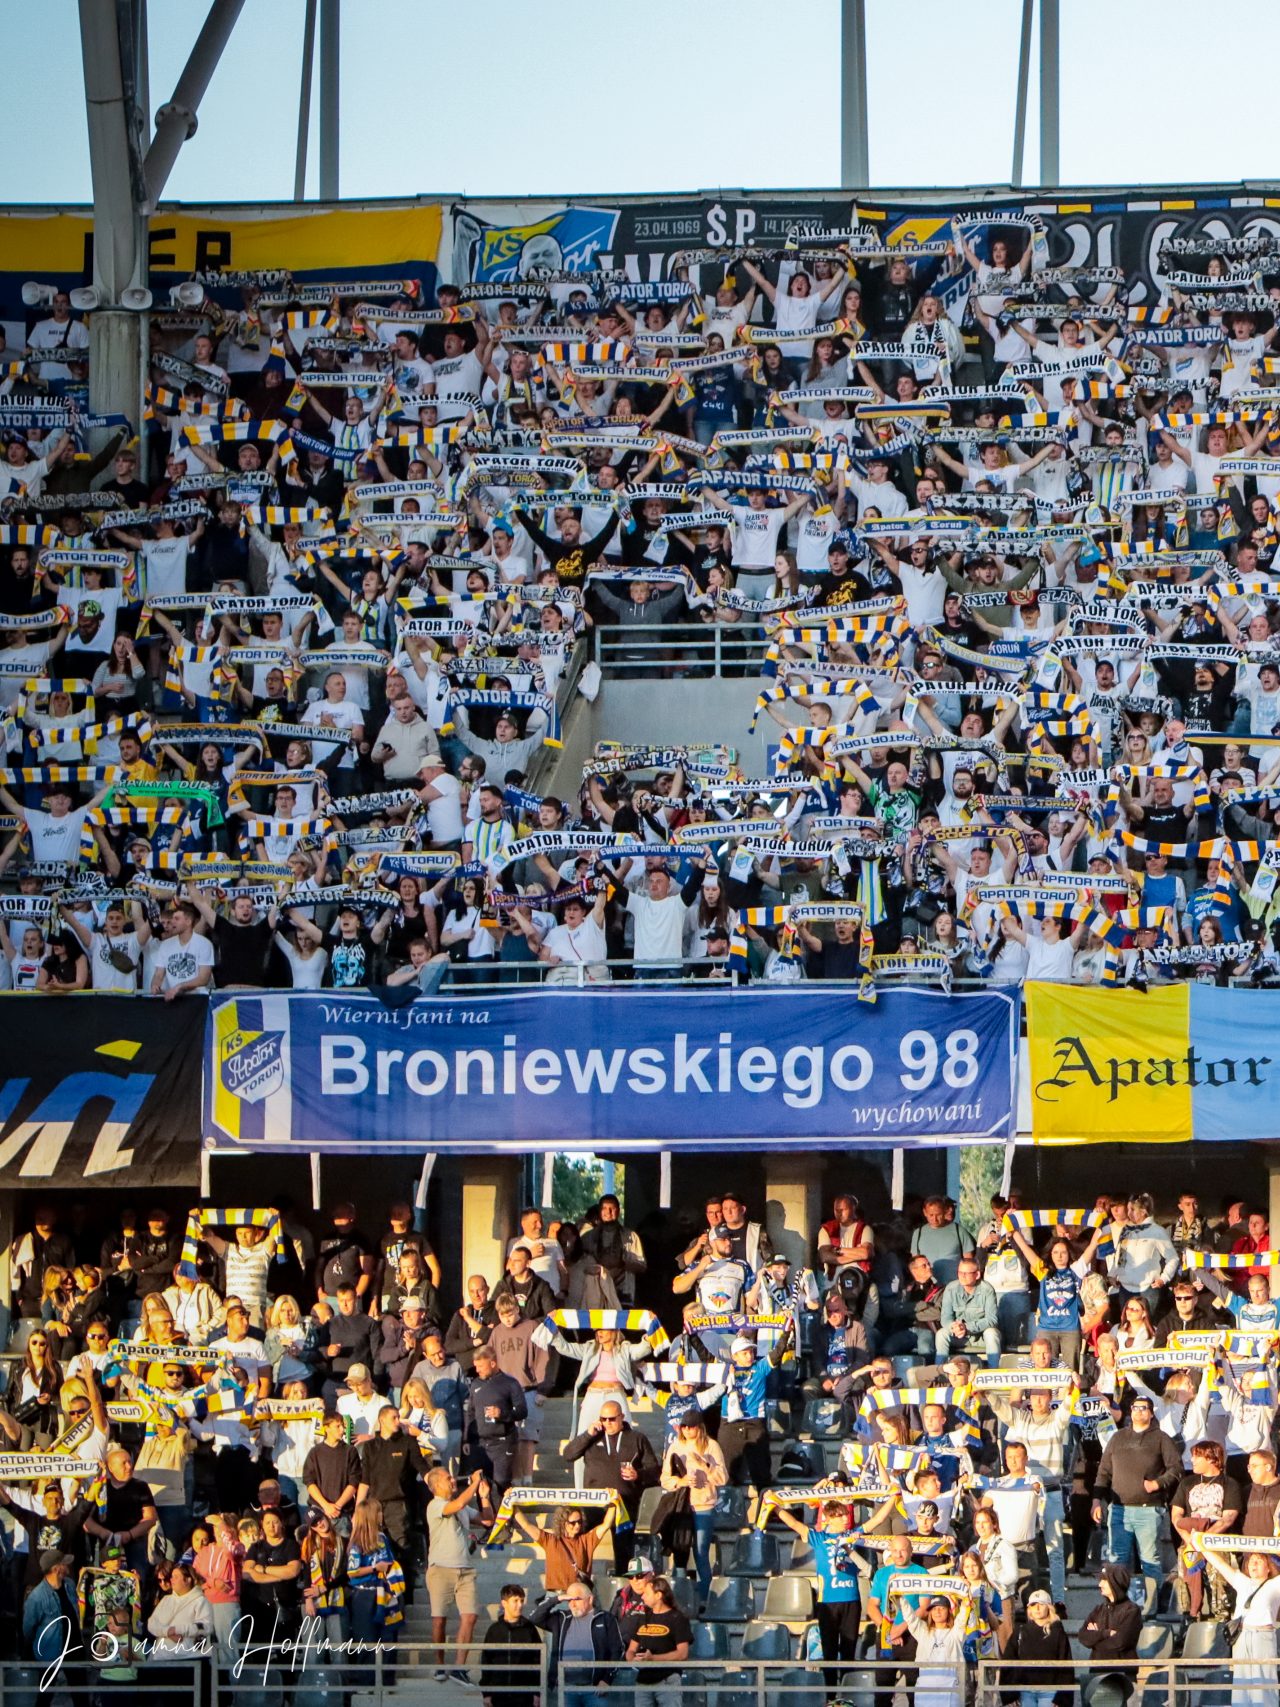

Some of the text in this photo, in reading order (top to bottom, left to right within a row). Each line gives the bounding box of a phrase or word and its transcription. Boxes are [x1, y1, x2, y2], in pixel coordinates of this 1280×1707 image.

[635, 220, 702, 238] 23.04.1969
[706, 204, 757, 247] Ś.P.
[485, 233, 522, 261] KS
[656, 282, 691, 298] TORU
[1185, 327, 1223, 342] TORU
[700, 472, 762, 487] APATOR
[515, 492, 566, 505] Apator
[986, 528, 1038, 541] Apator
[681, 825, 736, 839] APATOR
[507, 834, 565, 857] APATOR
[744, 837, 791, 850] PATOR
[1091, 876, 1129, 888] TORU
[978, 887, 1077, 902] APATOR TORUŃ
[319, 1004, 492, 1031] Wierni fani na
[225, 1033, 244, 1053] KS
[228, 1042, 277, 1088] Apator
[320, 1029, 981, 1109] Broniewskiego 98
[1035, 1036, 1273, 1103] Apator
[852, 1098, 983, 1132] wychowani
[116, 1342, 169, 1359] Apator
[975, 1373, 1029, 1386] APATOR
